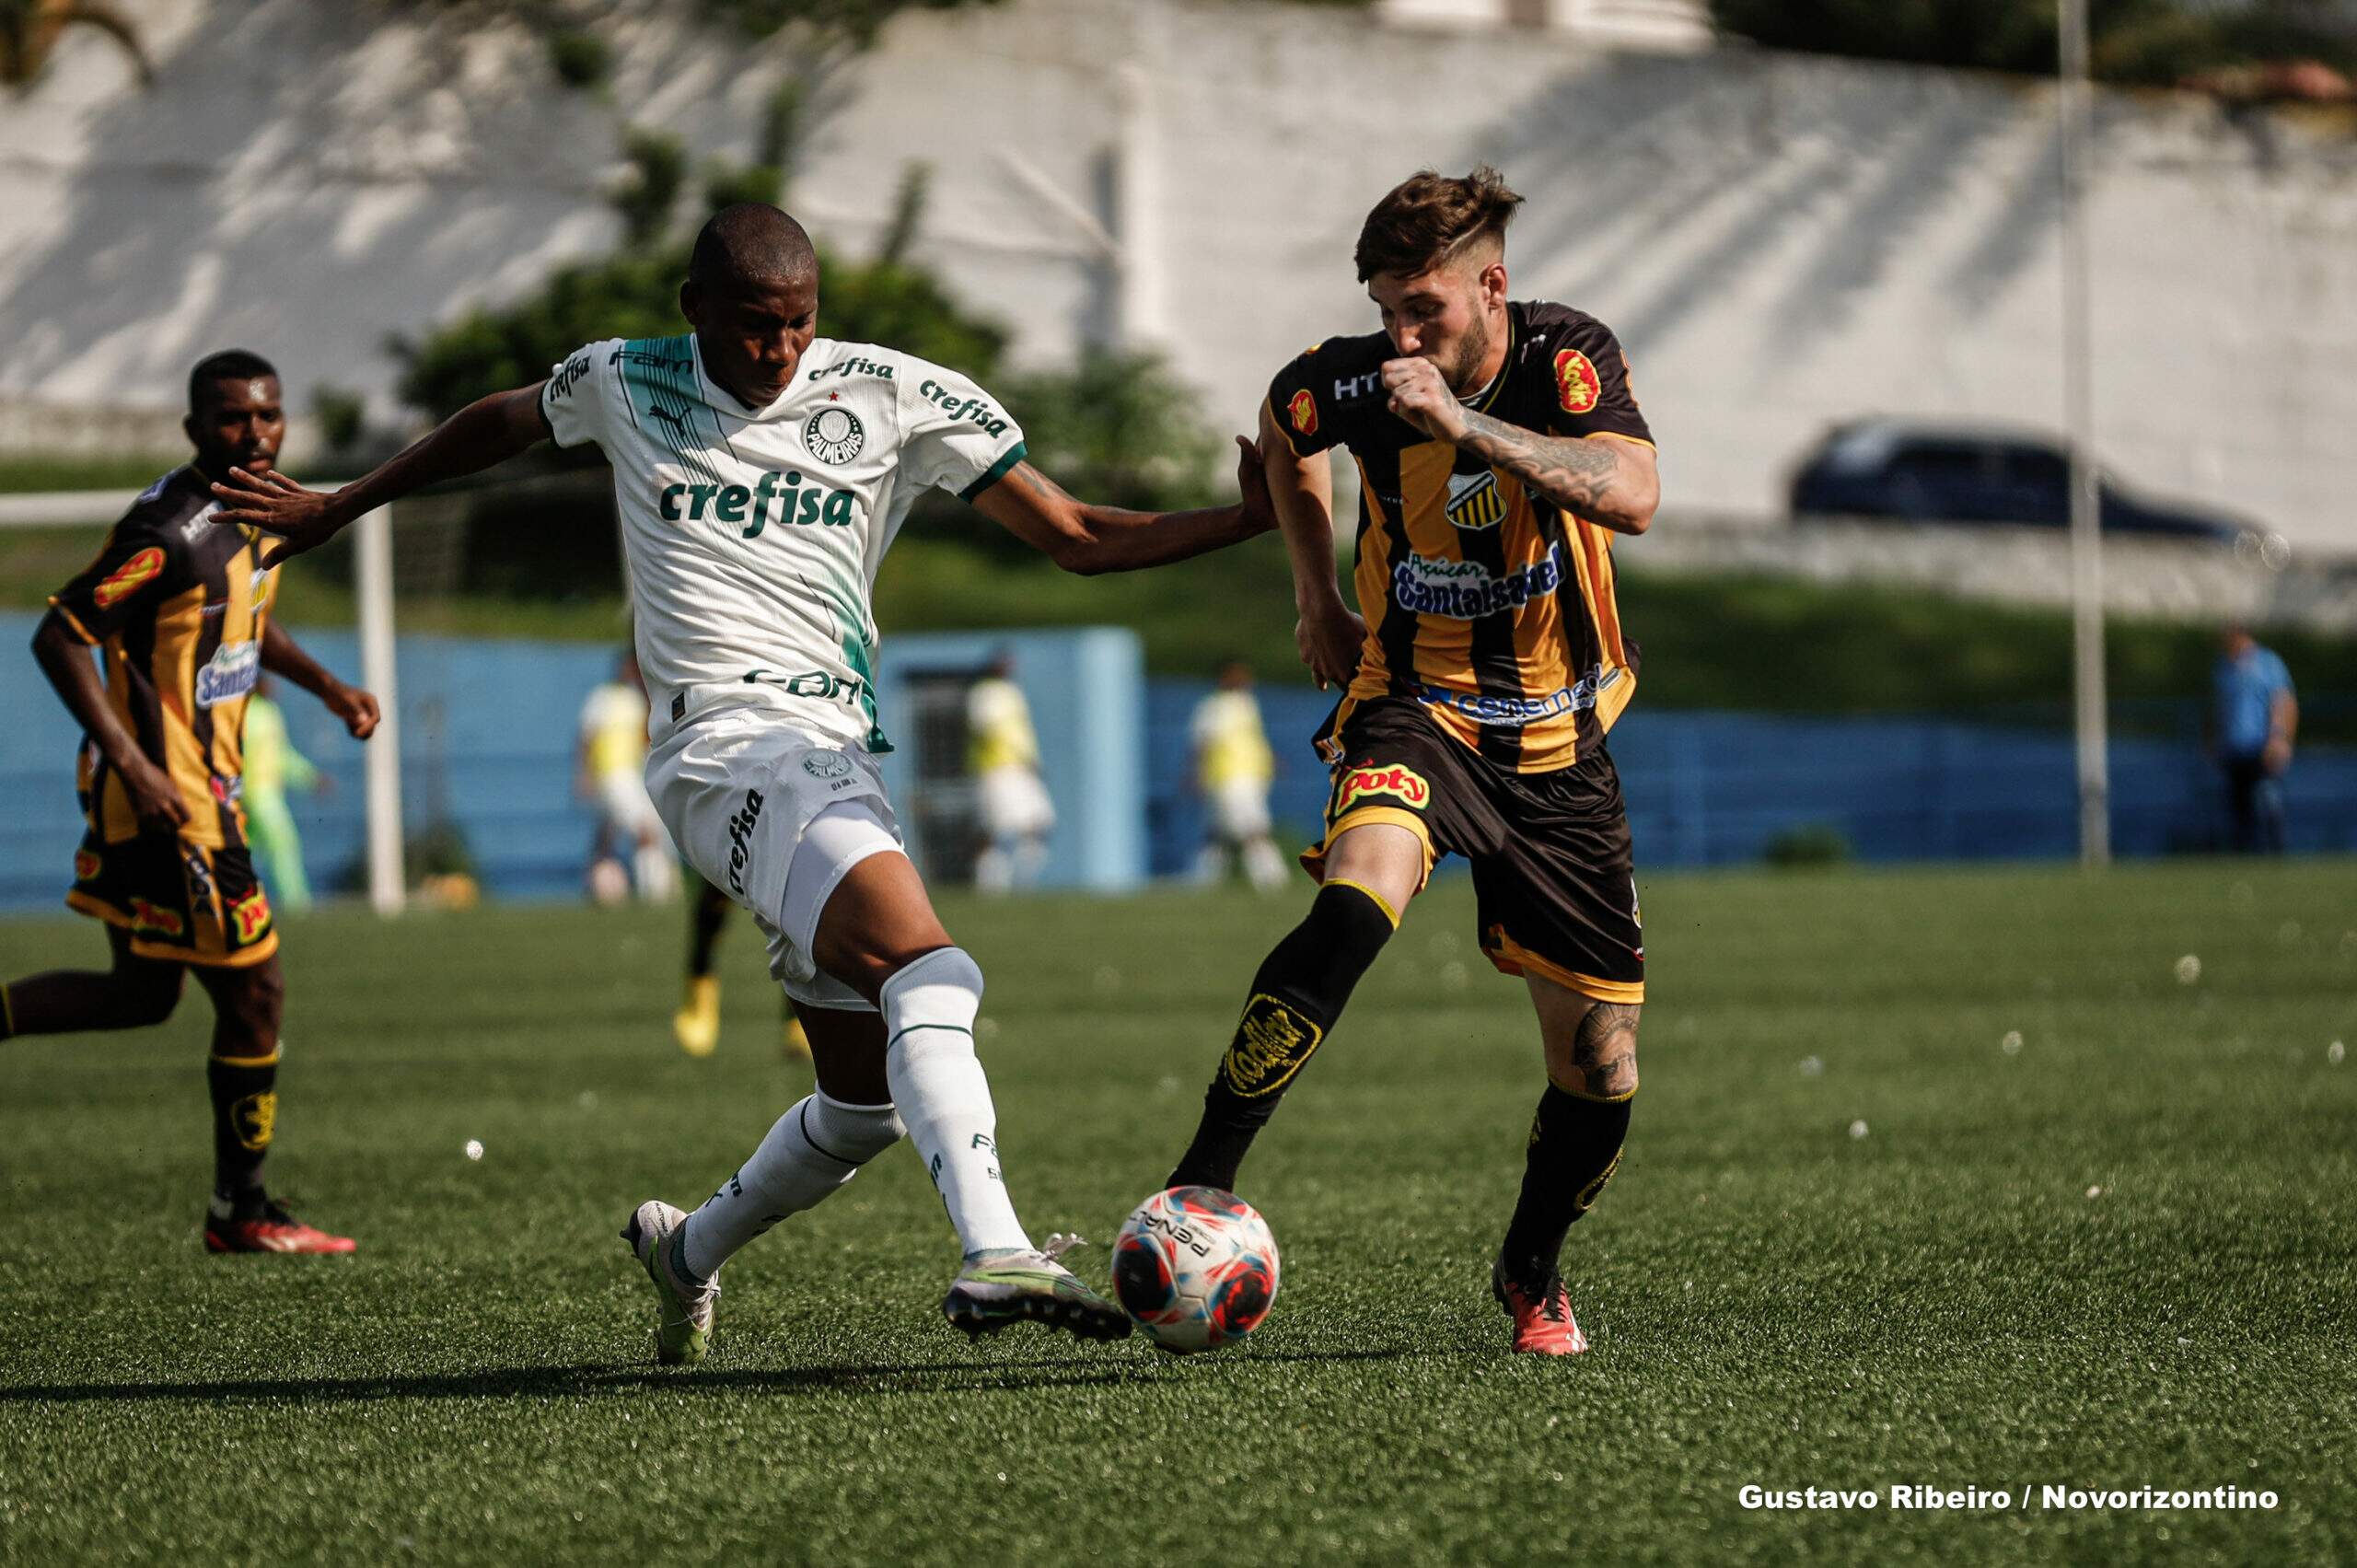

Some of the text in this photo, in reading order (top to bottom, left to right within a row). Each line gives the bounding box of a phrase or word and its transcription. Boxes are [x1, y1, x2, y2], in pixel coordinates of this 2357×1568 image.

[920, 379, 1008, 439] crefisa
[807, 433, 863, 464] PALMEIRAS
[659, 470, 856, 539] crefisa
[1339, 769, 1425, 810] poty
